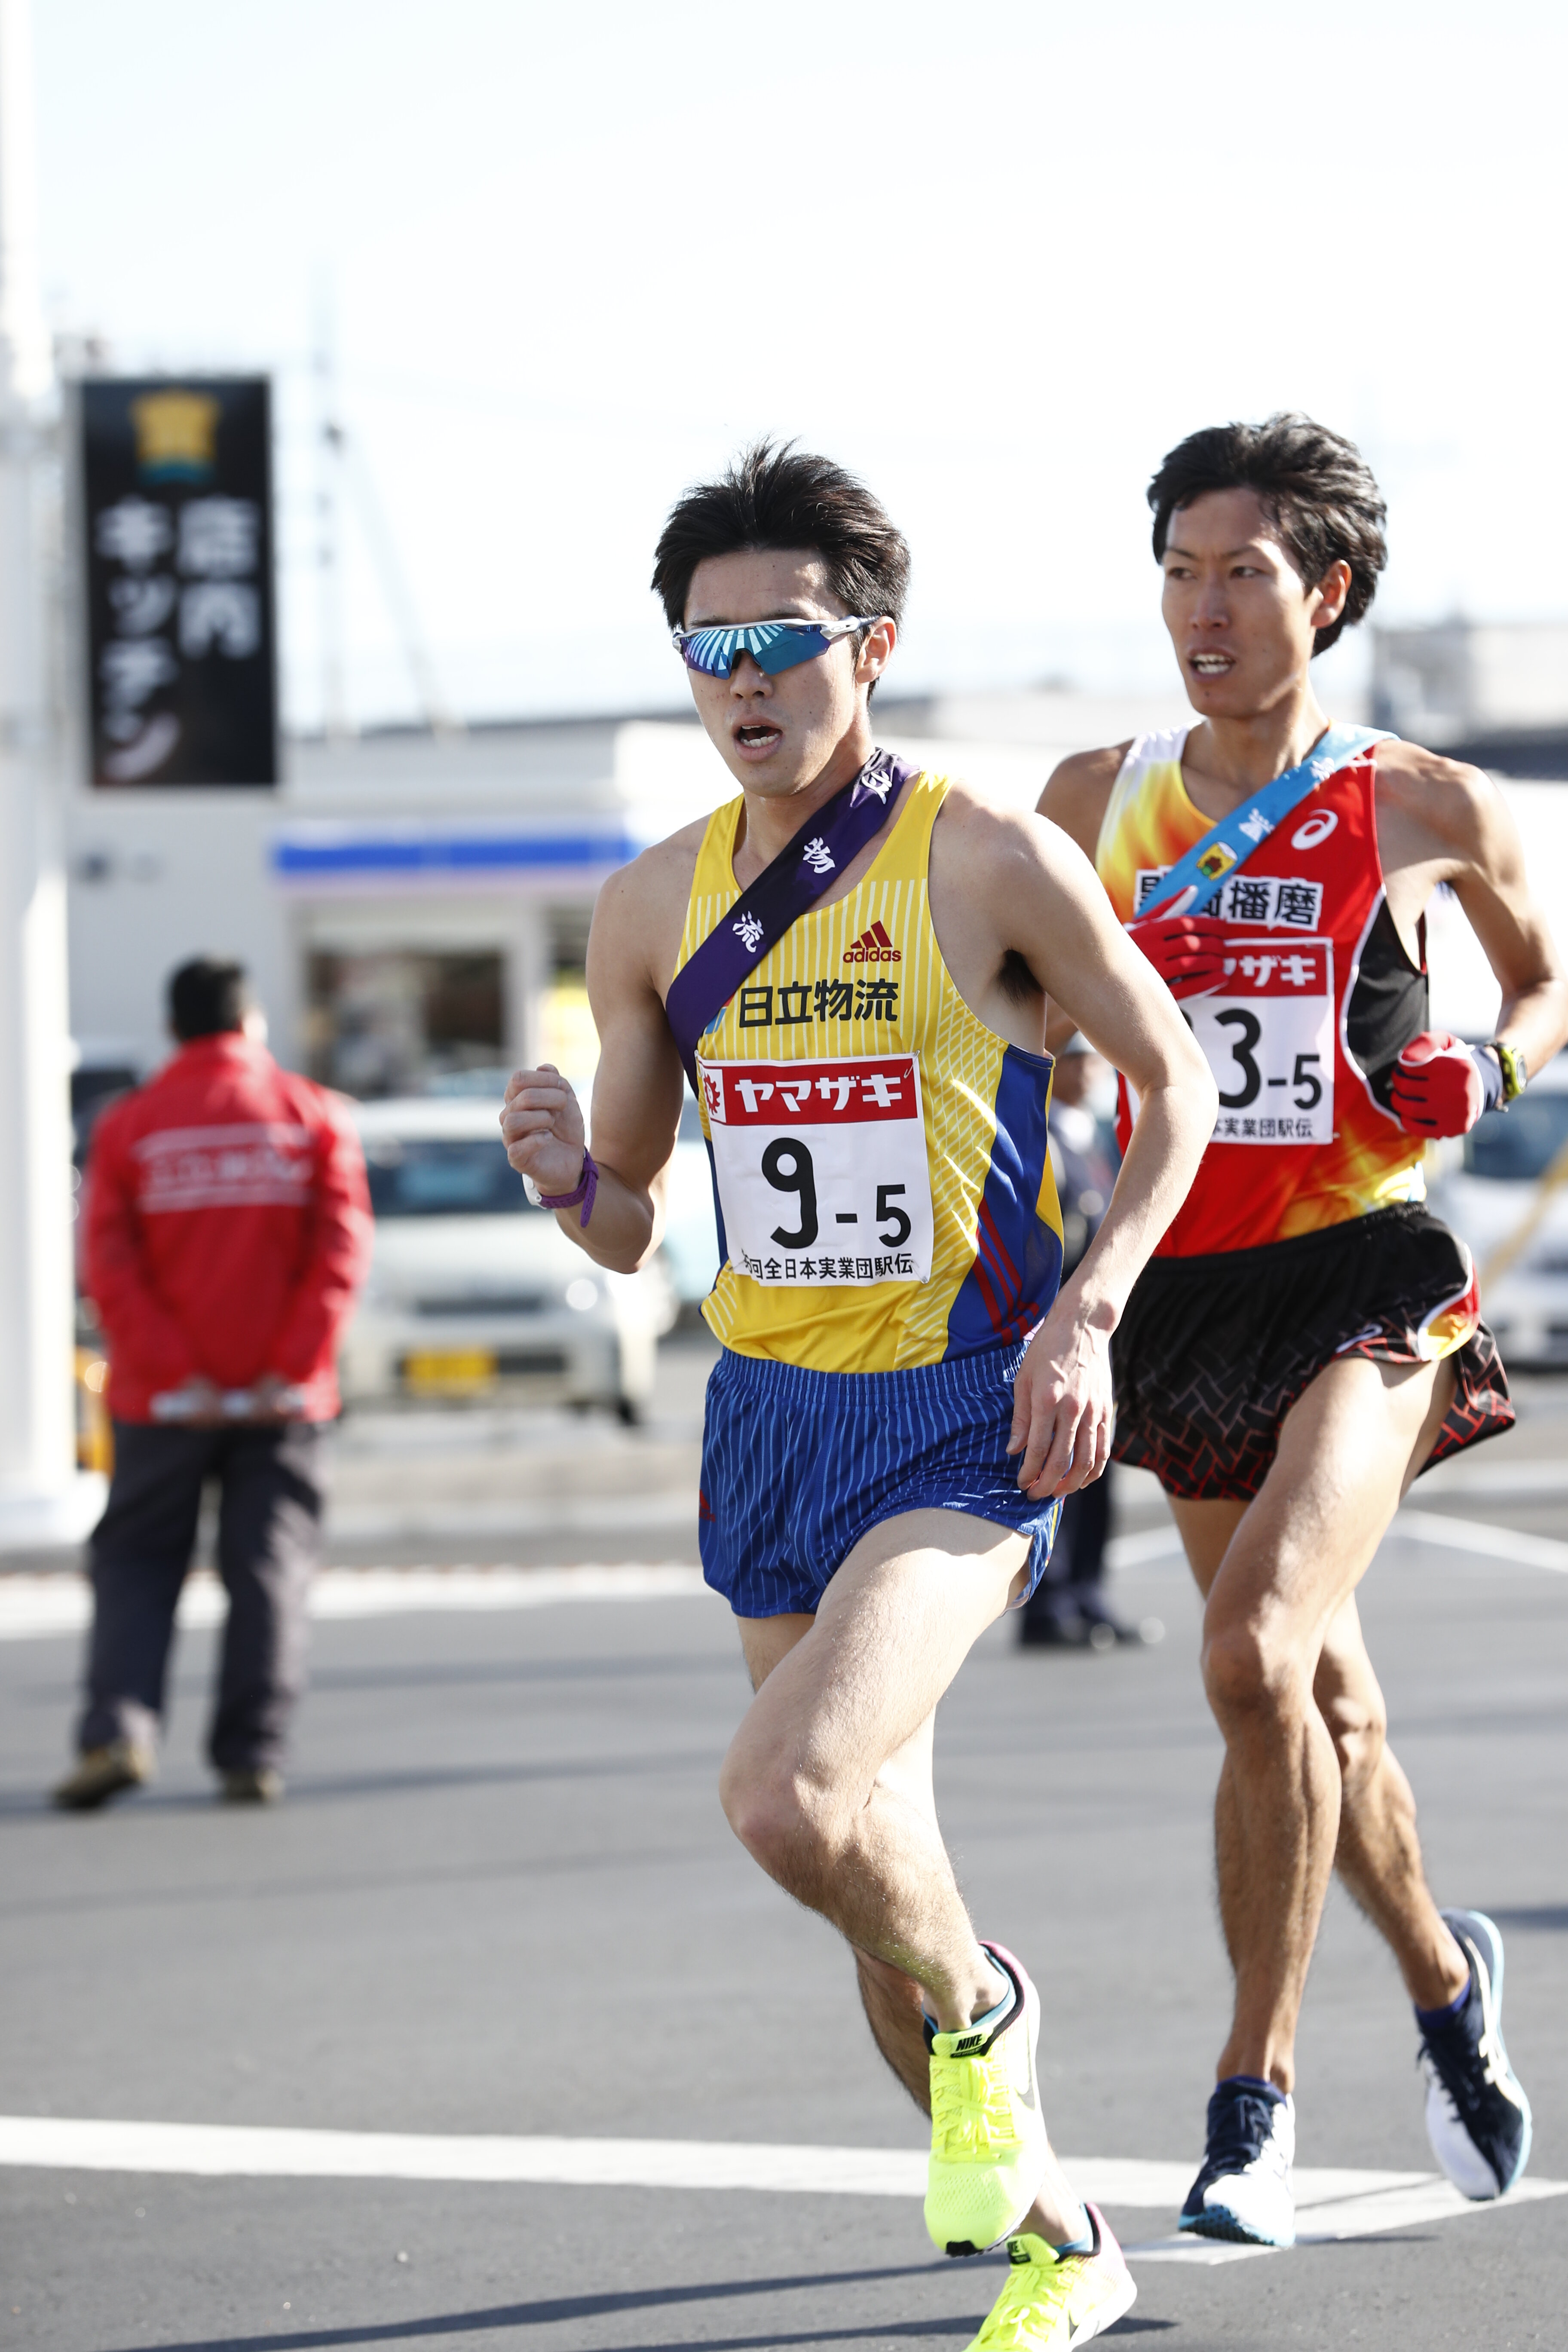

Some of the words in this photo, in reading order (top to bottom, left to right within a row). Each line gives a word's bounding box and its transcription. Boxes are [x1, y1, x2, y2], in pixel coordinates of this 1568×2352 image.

[842, 946, 901, 963] adidas
[739, 978, 899, 1028] 日立物流
[734, 1074, 902, 1113] ヤマザキ
[955, 2033, 983, 2052] NIKE
